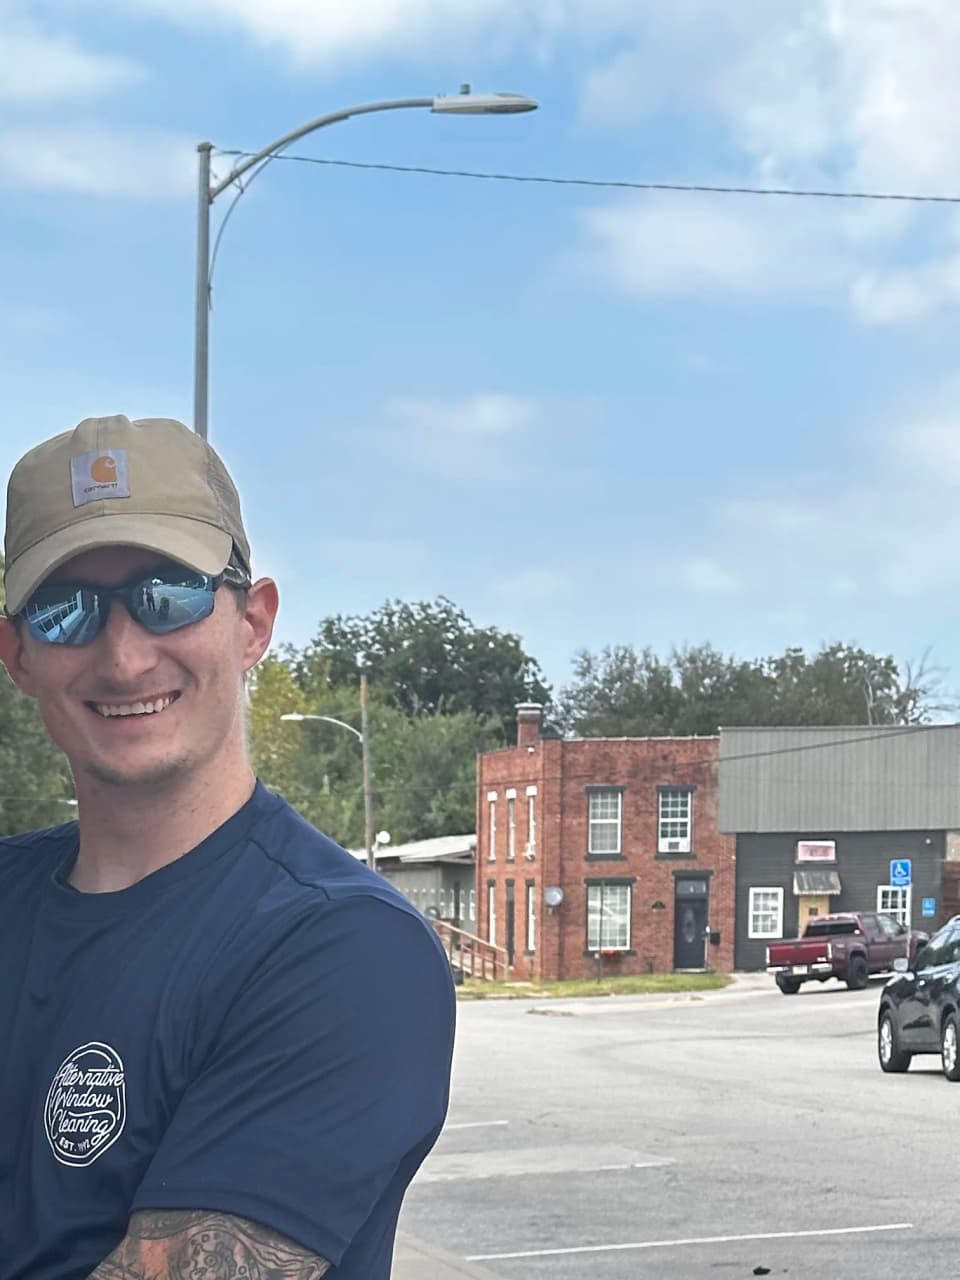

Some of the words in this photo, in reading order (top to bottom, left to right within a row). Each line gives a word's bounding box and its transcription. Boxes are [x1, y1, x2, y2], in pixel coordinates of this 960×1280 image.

[55, 1062, 125, 1087] Alternative
[51, 1086, 113, 1109] Window
[51, 1108, 116, 1146] Cleaning
